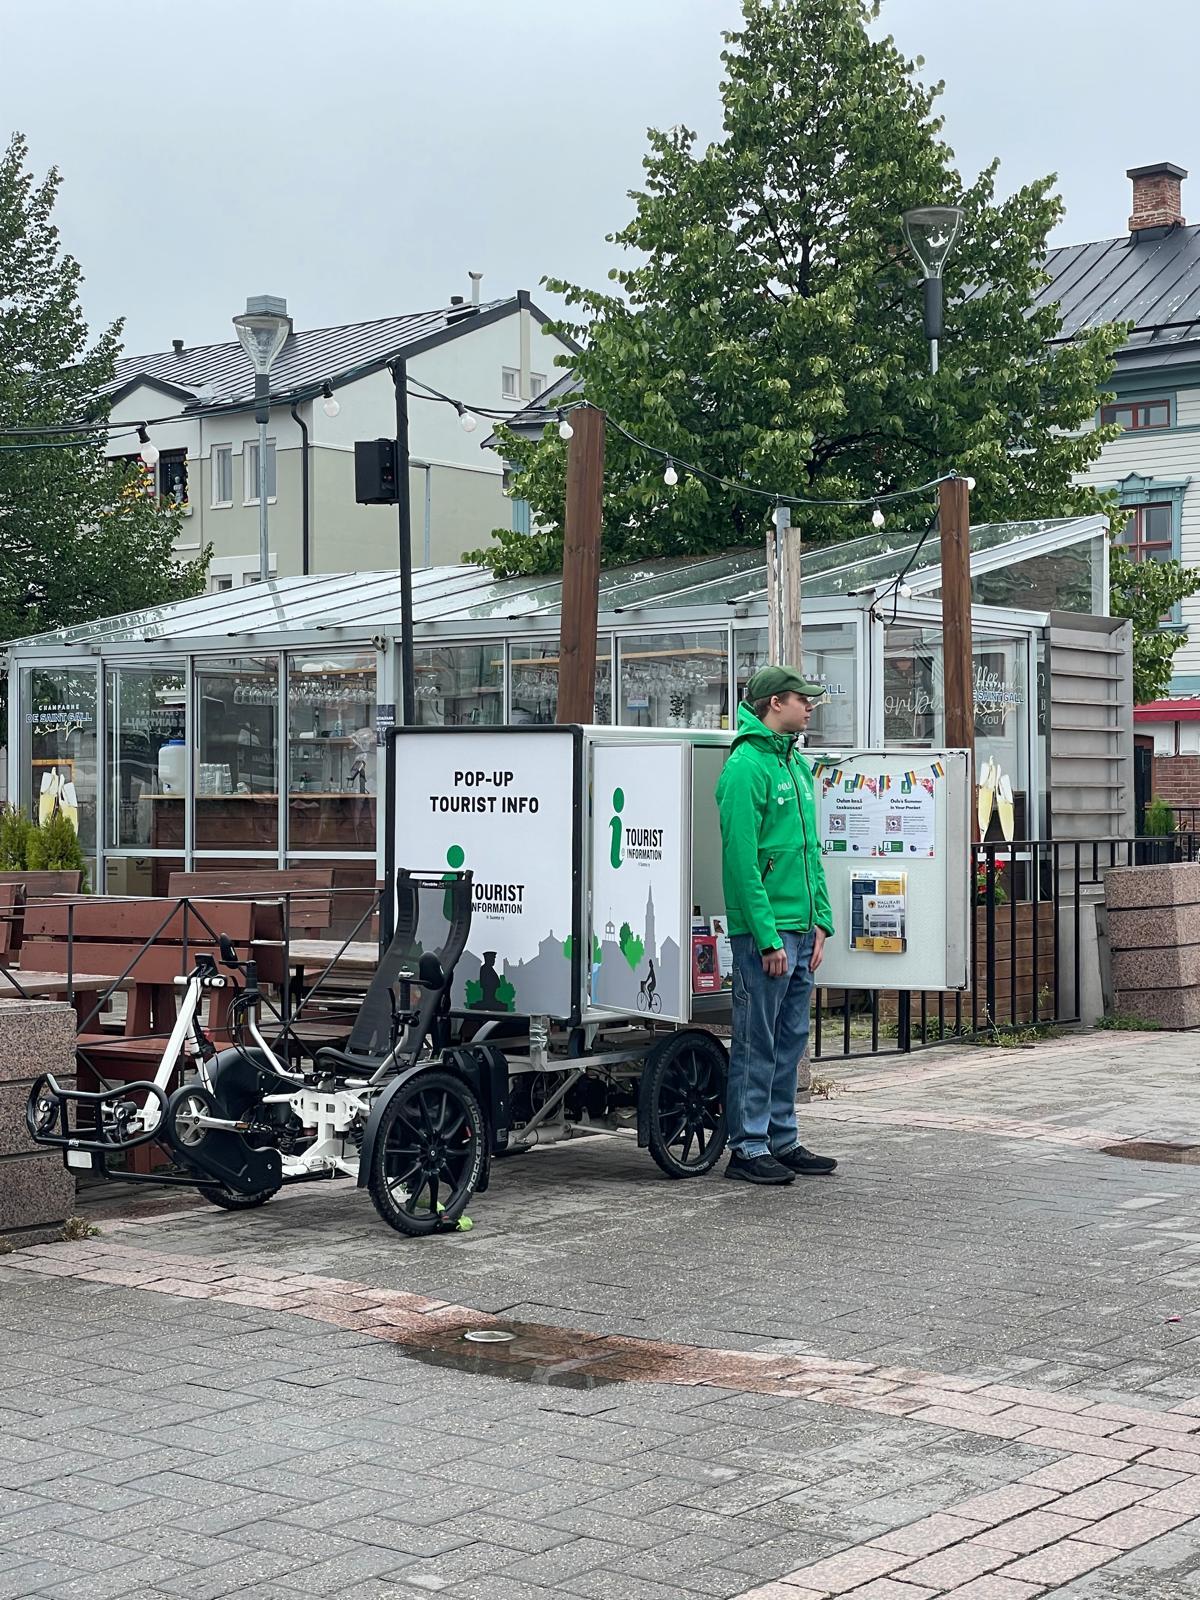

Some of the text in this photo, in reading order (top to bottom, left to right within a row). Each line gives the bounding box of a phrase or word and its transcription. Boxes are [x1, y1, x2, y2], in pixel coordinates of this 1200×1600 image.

[26, 712, 92, 723] DE SAINT GALL
[454, 771, 514, 787] POP-UP
[430, 796, 539, 813] TOURIST INFO
[625, 828, 663, 847] TOURIST
[626, 849, 662, 860] INFORMATION
[472, 903, 523, 914] NFORMATION
[466, 1136, 482, 1193] ROCKET
